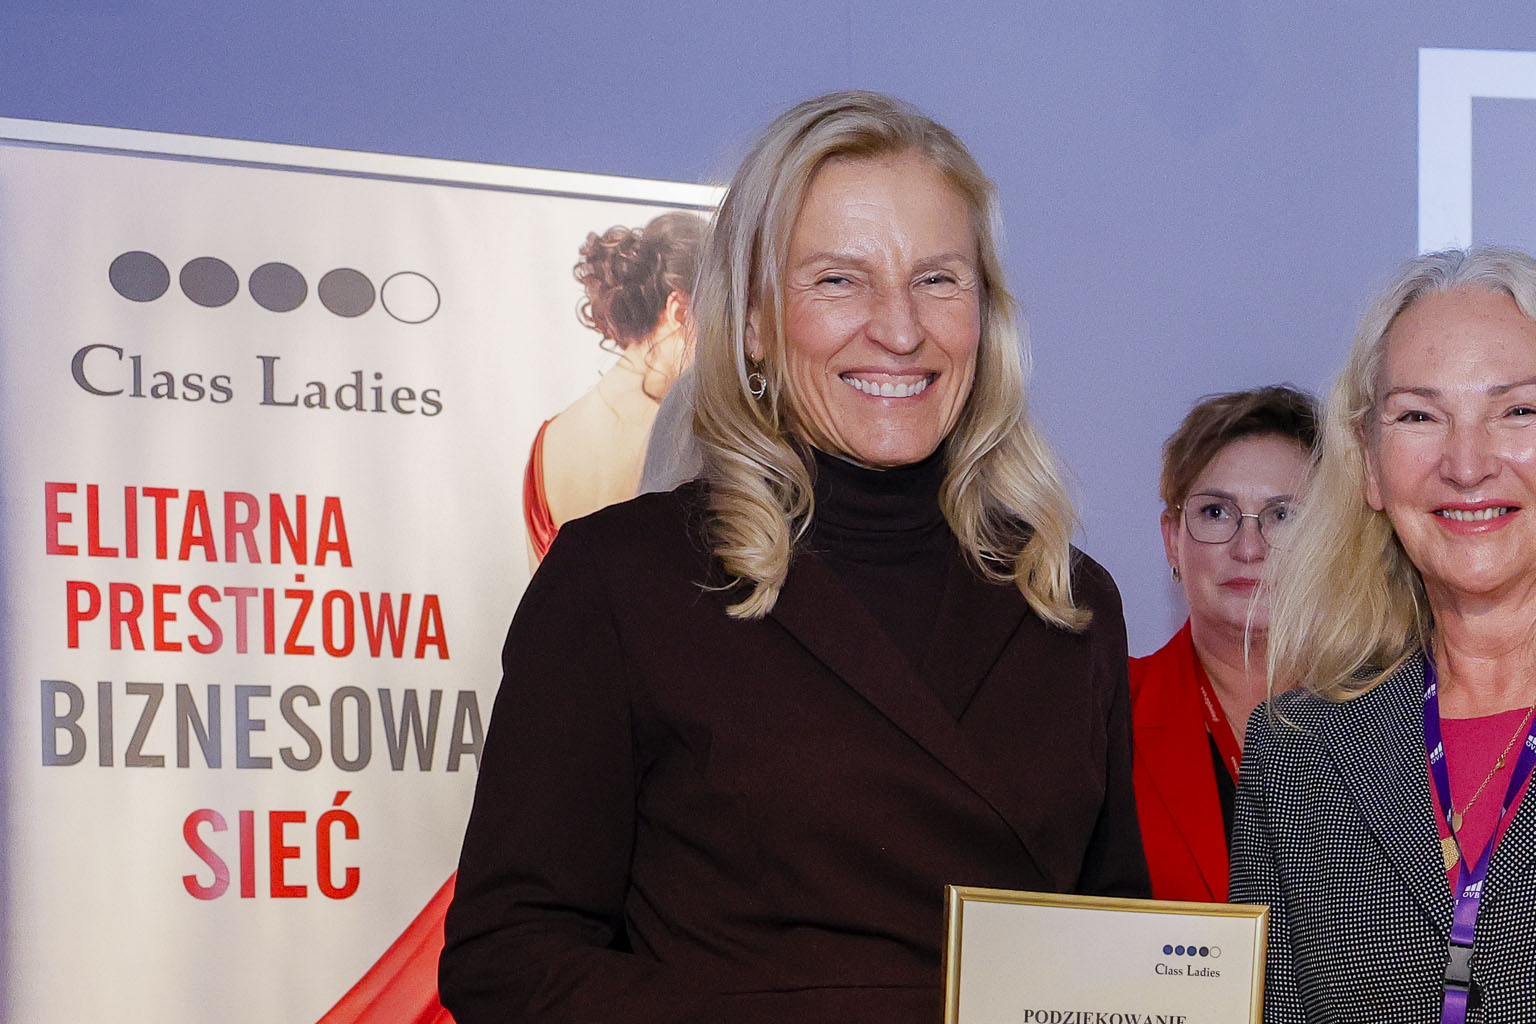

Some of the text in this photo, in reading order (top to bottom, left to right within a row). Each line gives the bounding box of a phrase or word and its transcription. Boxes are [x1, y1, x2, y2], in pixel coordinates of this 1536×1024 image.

[71, 343, 443, 417] Class Ladies
[44, 481, 353, 568] ELITARNA
[65, 573, 451, 660] PRESTIŻOWA
[40, 679, 485, 772] BIZNESOWA
[181, 790, 360, 900] SIEĆ
[1155, 963, 1221, 978] Class Ladies
